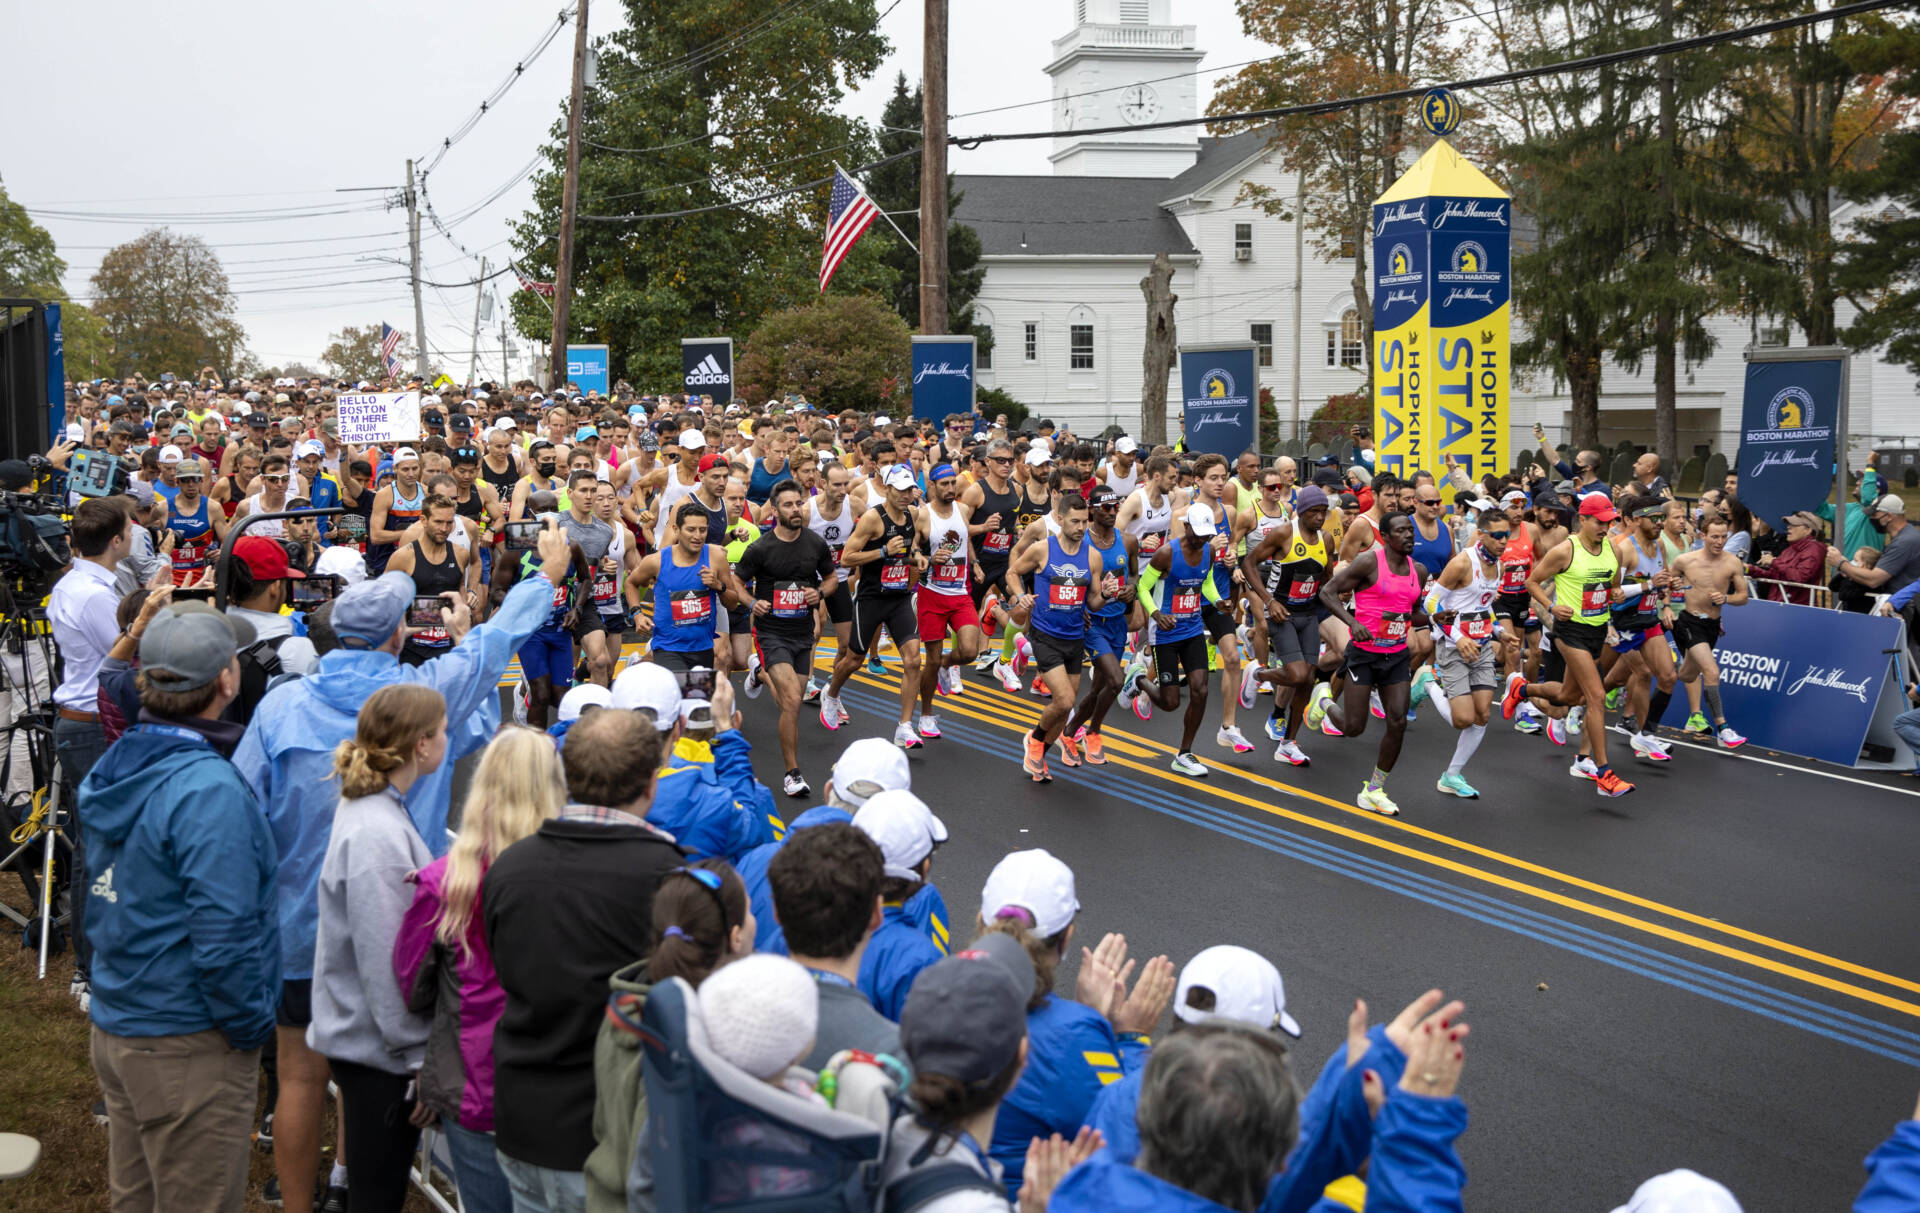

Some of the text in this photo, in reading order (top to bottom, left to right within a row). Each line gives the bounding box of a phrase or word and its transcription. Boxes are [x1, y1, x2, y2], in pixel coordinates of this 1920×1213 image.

[1376, 202, 1427, 237] John Hancock
[1433, 200, 1508, 230] John Hancock
[1443, 288, 1464, 308] John
[685, 373, 730, 385] adidas
[913, 362, 938, 385] John
[339, 395, 377, 405] HELLO
[340, 404, 386, 415] BOSTON
[1213, 398, 1248, 406] MARATHON
[1380, 339, 1404, 480] STA
[1408, 351, 1420, 470] HOPKINT
[340, 413, 388, 424] I'M HERE
[1438, 337, 1473, 491] STAR
[1480, 351, 1497, 480] HOPKINT
[341, 432, 391, 443] THIS CITY!
[355, 423, 377, 433] RUN
[1746, 430, 1830, 441] BOSTON MARATHON
[1750, 449, 1820, 478] John Hancock
[553, 587, 563, 601] 22
[1058, 586, 1078, 600] 554
[1719, 650, 1781, 674] BOSTON
[1719, 668, 1776, 691] ATHON
[1786, 664, 1872, 703] John Hancock
